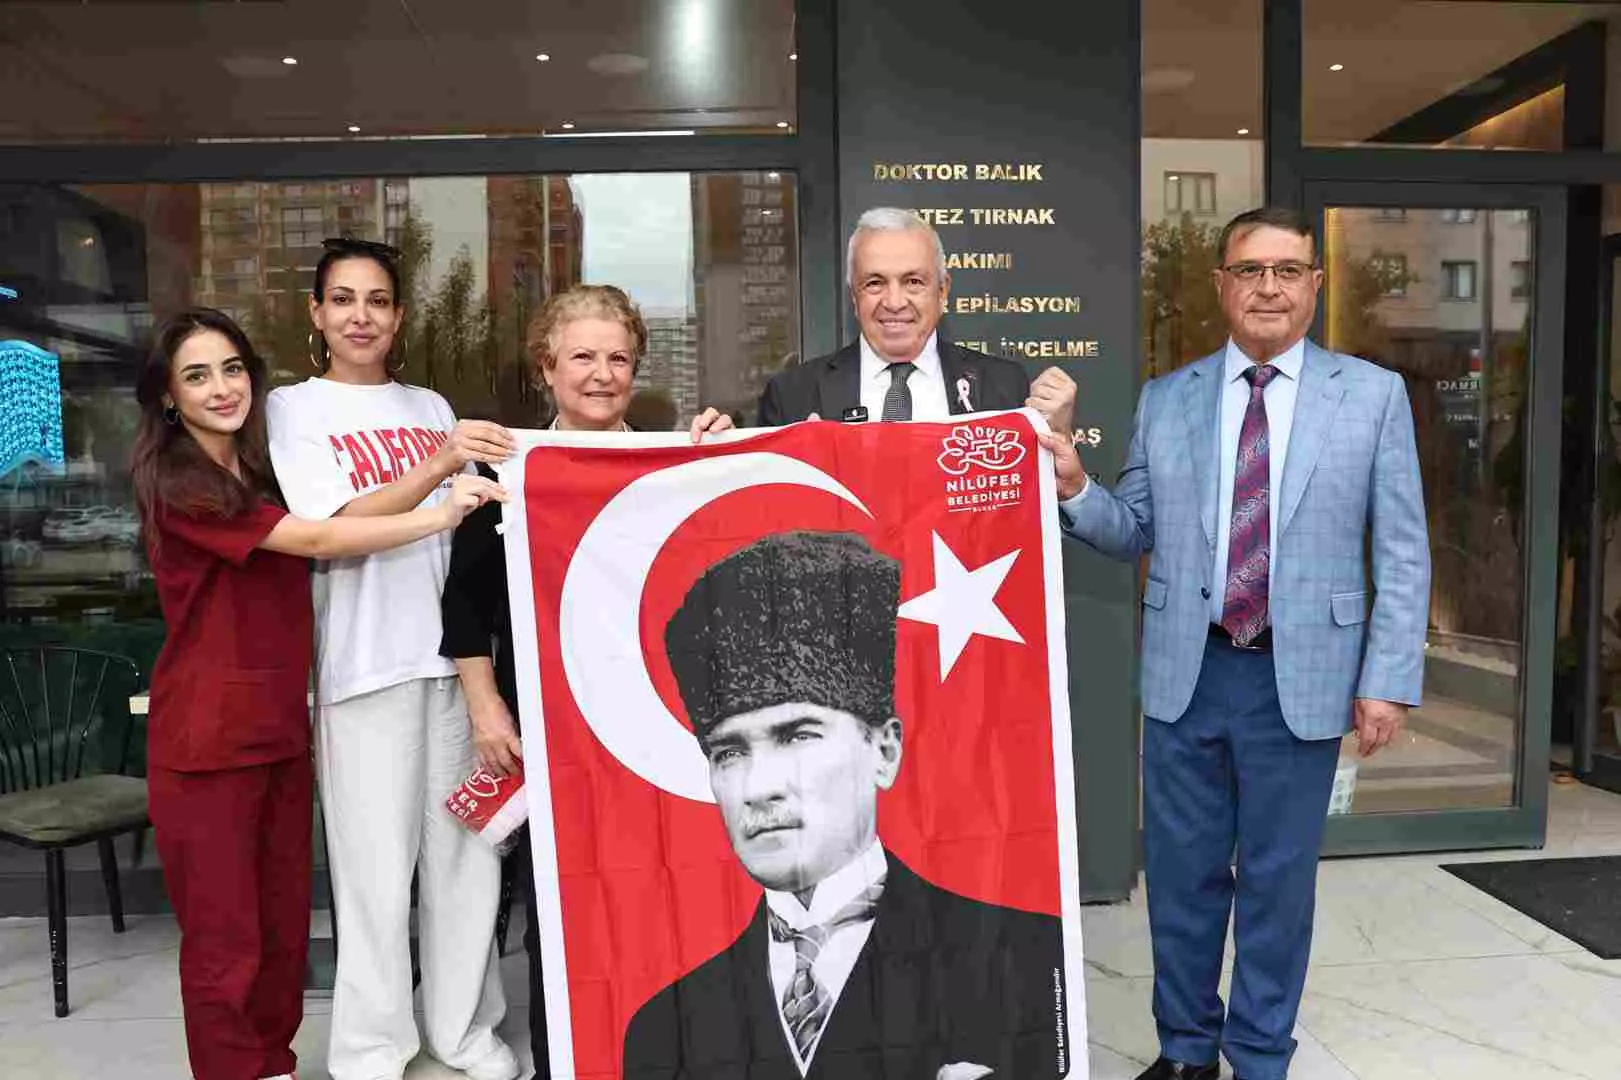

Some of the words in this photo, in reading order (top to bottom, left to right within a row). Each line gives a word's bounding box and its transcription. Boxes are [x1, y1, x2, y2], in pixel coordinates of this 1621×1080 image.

[874, 163, 969, 181] DOKTOR
[975, 163, 1043, 181] BALIK
[914, 208, 964, 225] TEZ
[970, 208, 1056, 225] TIRNAK
[956, 293, 1080, 313] EPİLASYON
[1001, 336, 1099, 357] İNCELME
[946, 473, 1022, 492] NİLÜFER
[947, 487, 1020, 506] BELEDİYESİ
